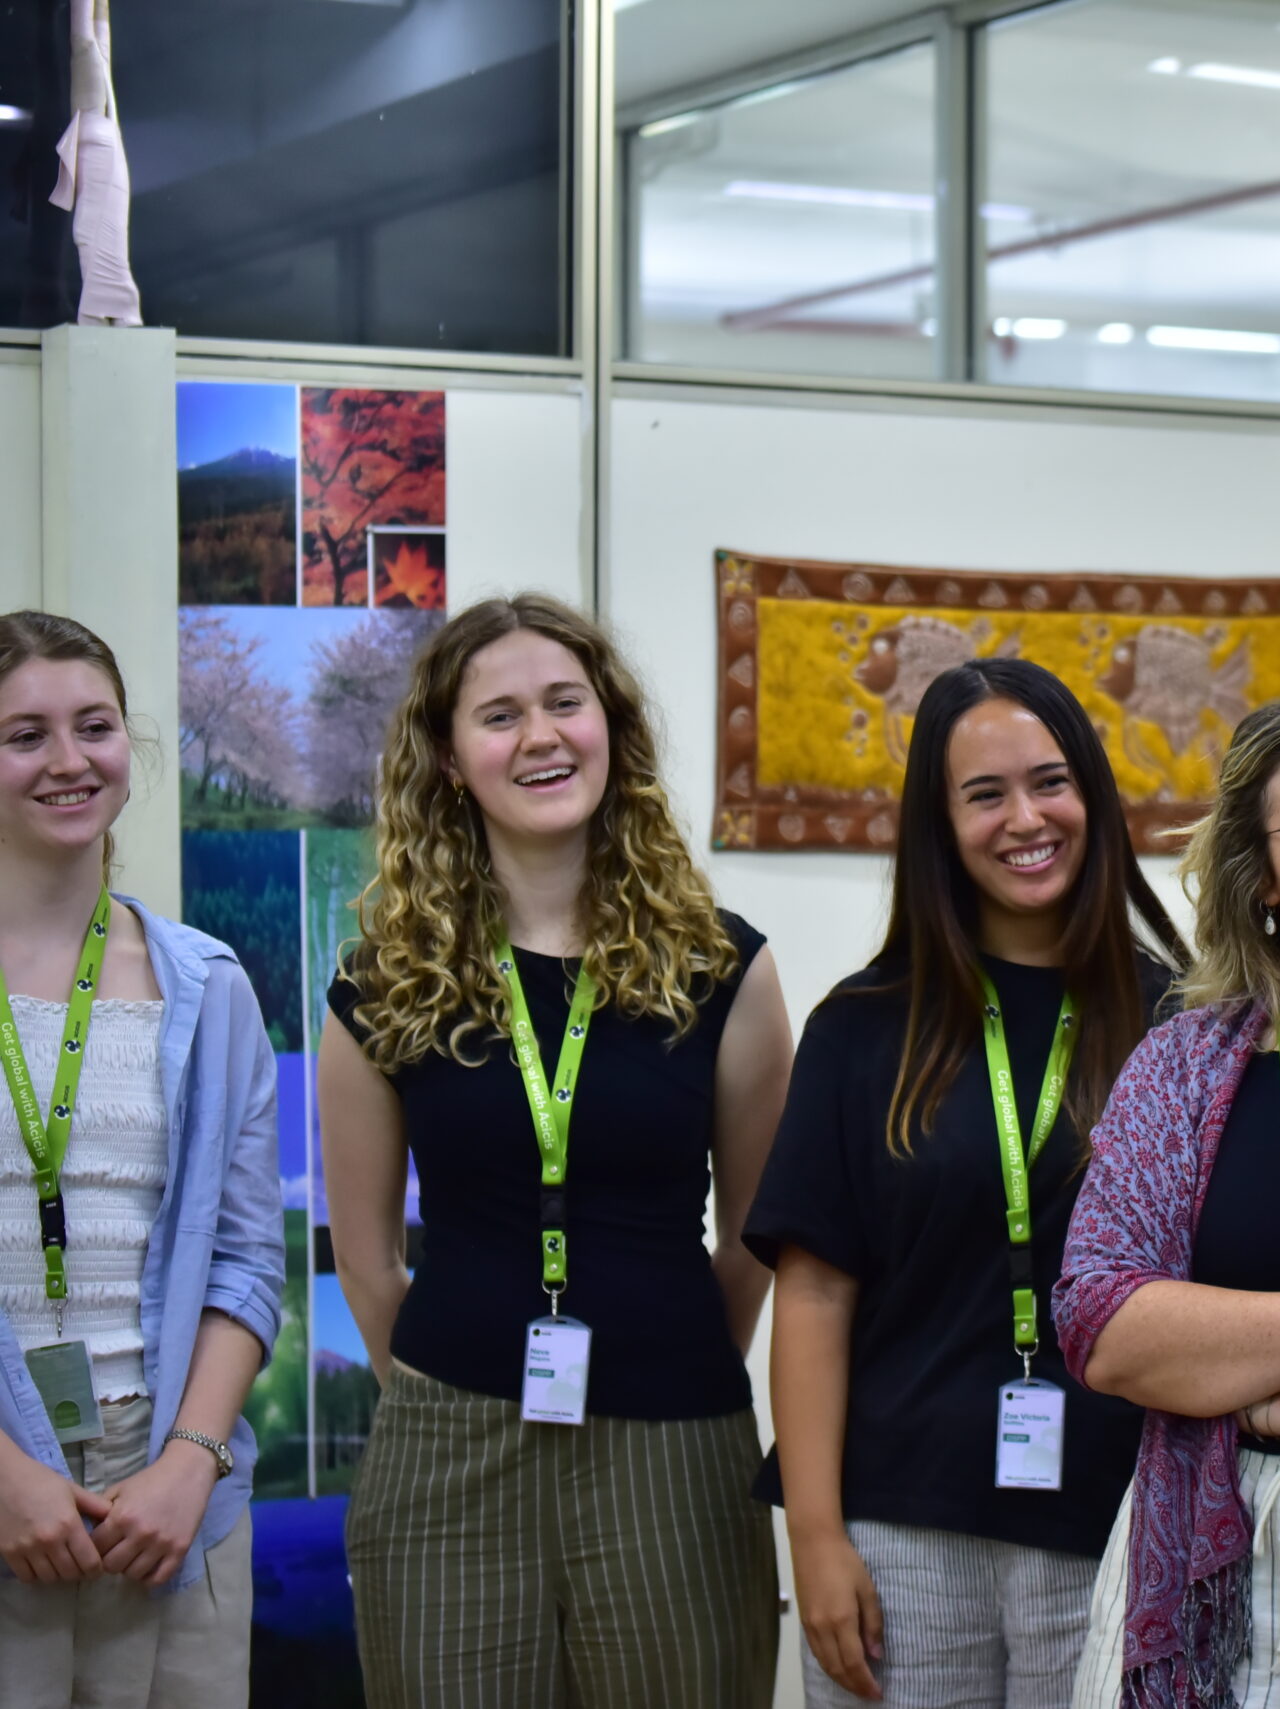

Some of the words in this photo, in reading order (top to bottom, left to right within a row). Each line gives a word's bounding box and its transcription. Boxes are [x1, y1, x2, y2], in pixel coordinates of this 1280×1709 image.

[1, 1022, 15, 1046] Get
[6, 1048, 27, 1089] global
[997, 1070, 1008, 1095] Get
[19, 1088, 34, 1118] with
[530, 1082, 546, 1109] with
[539, 1111, 554, 1149] Acicis
[998, 1095, 1016, 1133] global
[1037, 1099, 1054, 1139] global
[27, 1120, 45, 1159] Acicis
[1007, 1136, 1020, 1165] with
[1011, 1169, 1022, 1207] Acicis
